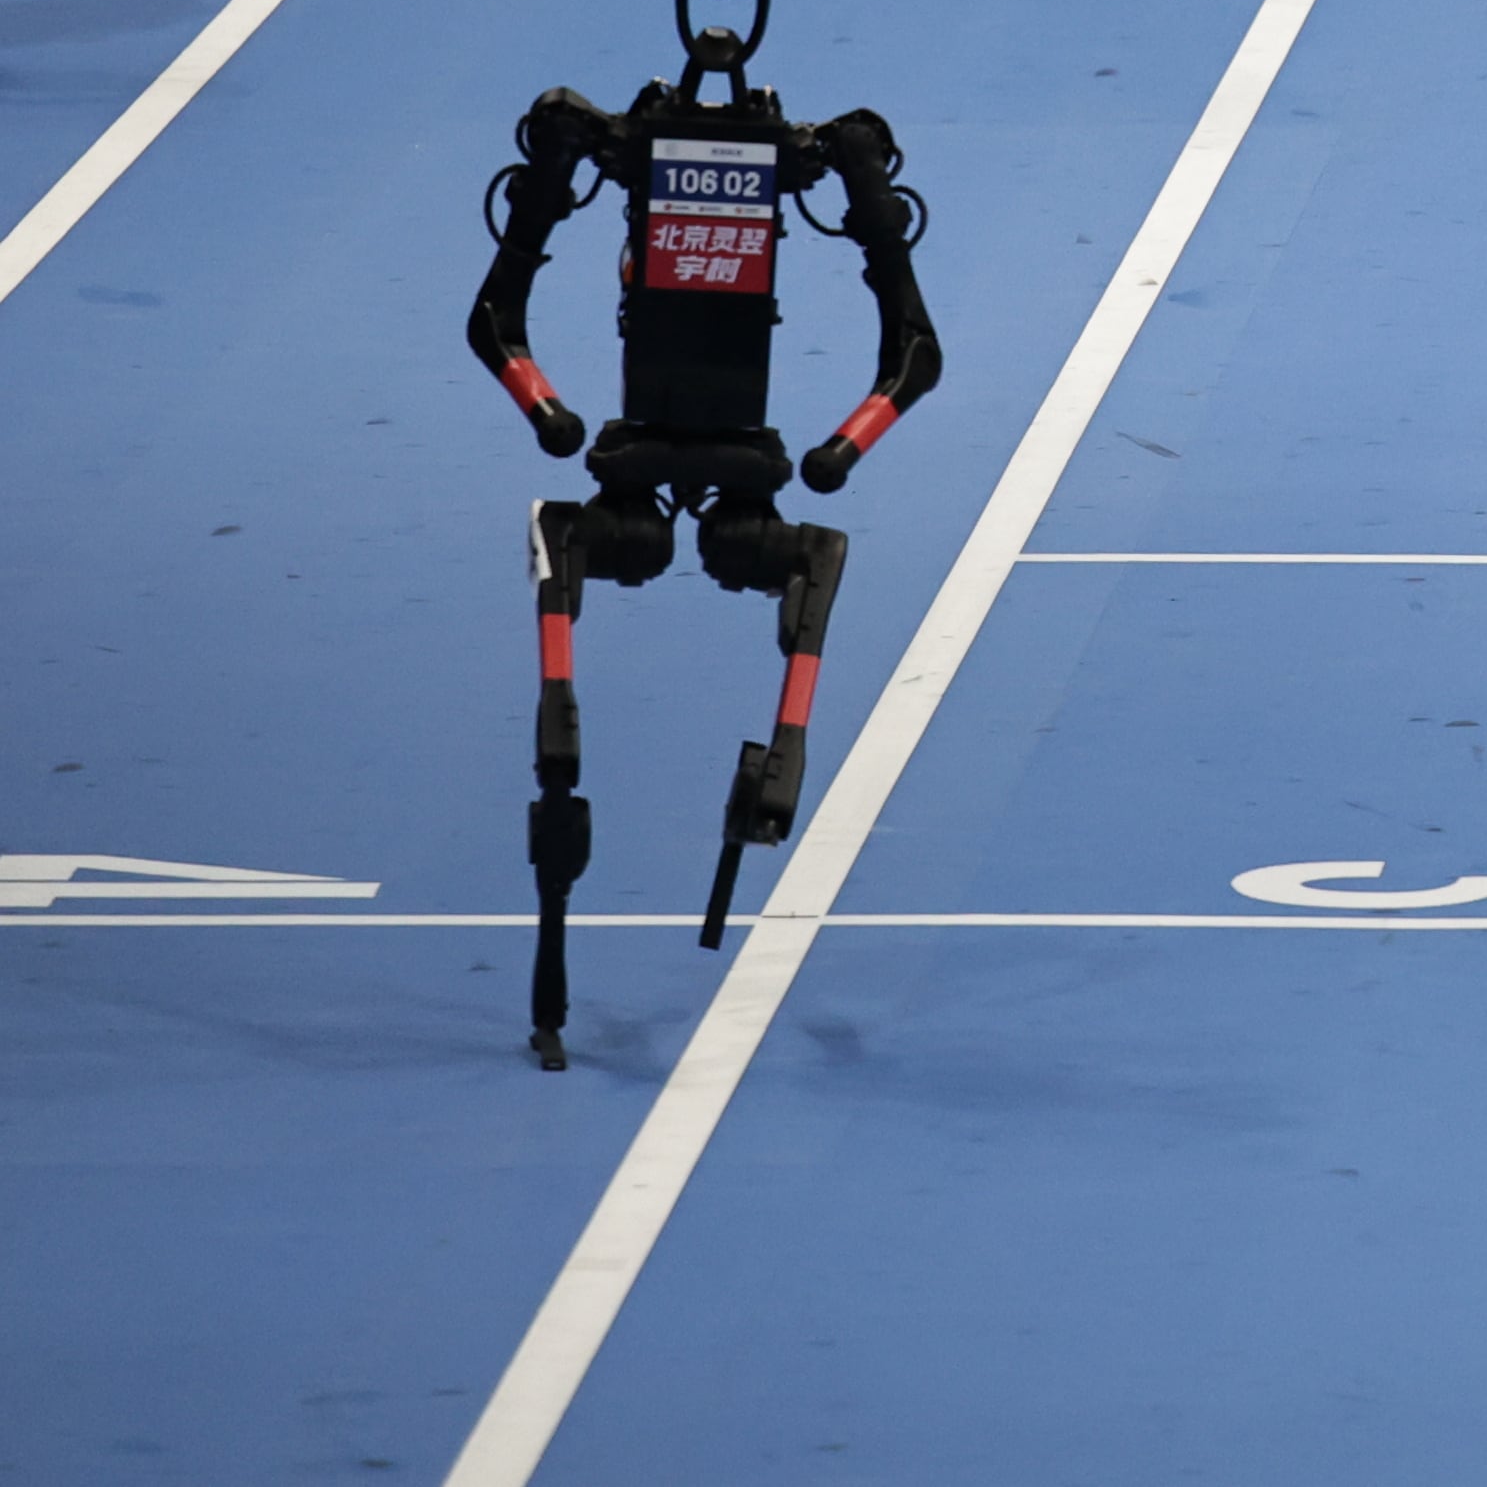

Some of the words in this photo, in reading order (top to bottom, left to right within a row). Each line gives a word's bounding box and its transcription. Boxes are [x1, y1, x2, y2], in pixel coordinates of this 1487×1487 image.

[651, 224, 768, 255] 北京灵翌
[673, 255, 743, 284] 宇树
